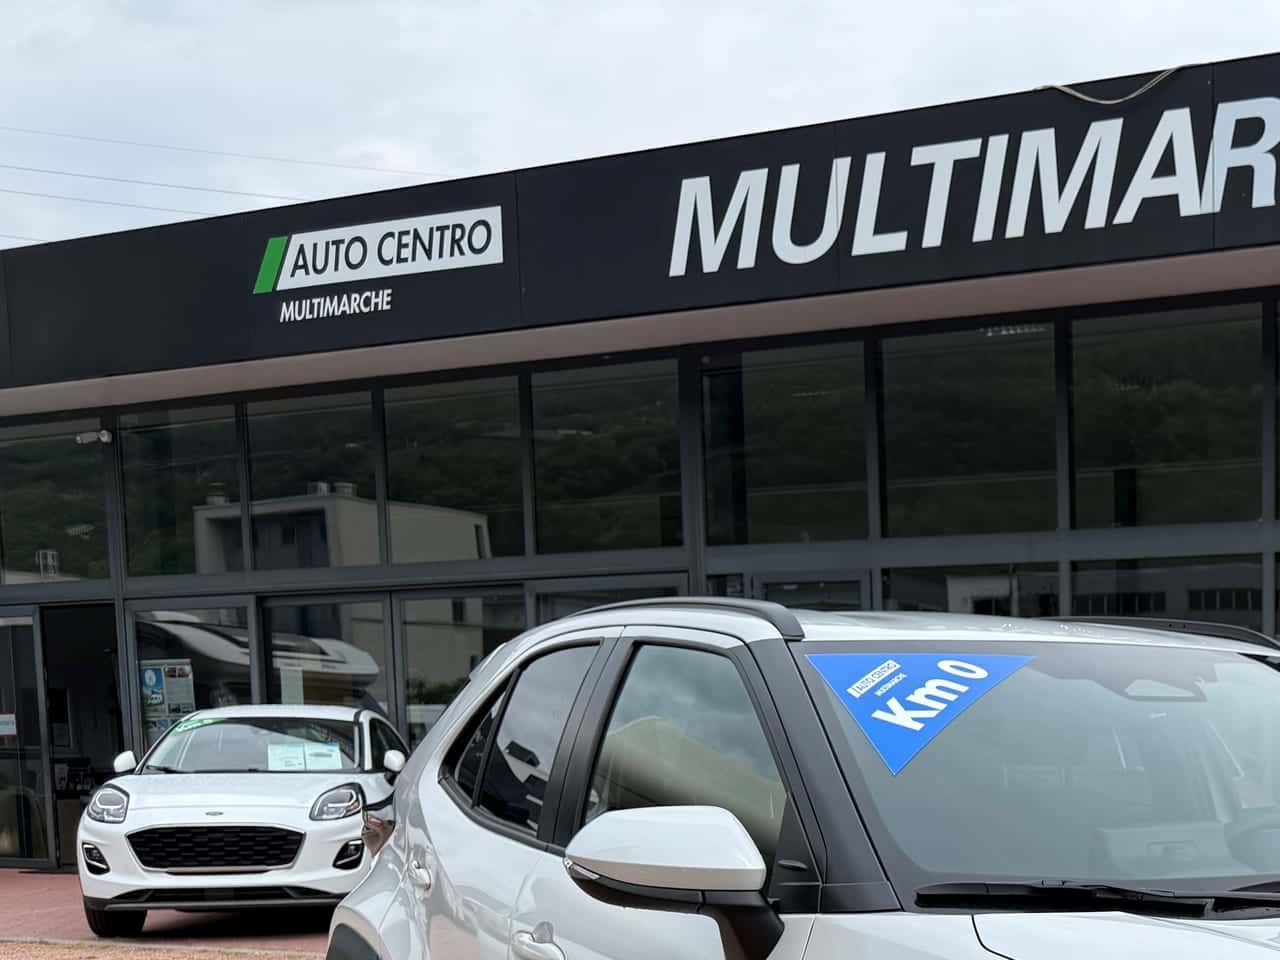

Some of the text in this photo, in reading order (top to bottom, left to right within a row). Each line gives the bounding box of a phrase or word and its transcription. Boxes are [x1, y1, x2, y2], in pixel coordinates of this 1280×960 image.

[290, 219, 492, 278] AUTO CENTRO
[279, 289, 393, 323] MULTIMARCHE
[871, 678, 969, 732] Km
[937, 660, 989, 680] 0
